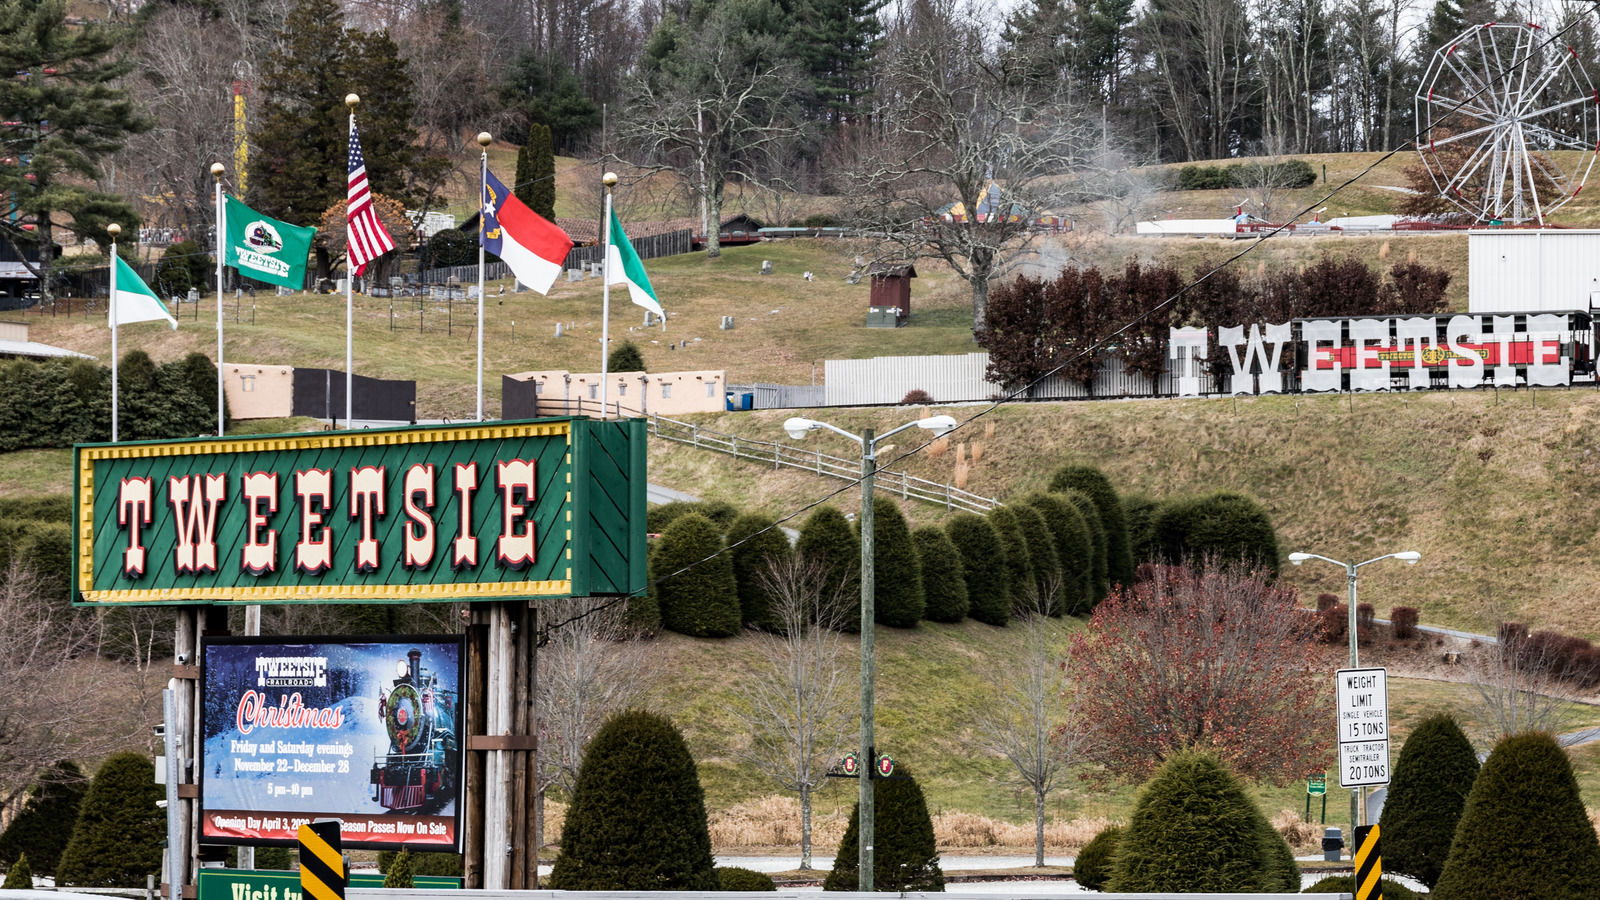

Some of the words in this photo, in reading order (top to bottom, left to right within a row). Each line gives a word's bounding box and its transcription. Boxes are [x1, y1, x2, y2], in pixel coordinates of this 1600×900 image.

[1170, 315, 1569, 396] TWEETSIE
[117, 458, 537, 580] TWEETSIE
[256, 657, 328, 687] TWEETSIE
[1347, 675, 1377, 689] WEIGHT
[1351, 694, 1372, 707] LIMIT
[237, 690, 345, 734] Christmas
[1343, 711, 1360, 719] SINGLE
[1363, 709, 1383, 718] VEHICLE
[1348, 722, 1360, 737] 15
[1362, 722, 1384, 736] TONS
[231, 740, 258, 757] Friday
[259, 741, 275, 754] and
[277, 741, 315, 758] Saturday
[316, 741, 354, 758] evenings
[1343, 745, 1360, 753] TRUCK
[1363, 743, 1385, 752] TRACTOR
[234, 758, 275, 772] November
[337, 760, 350, 773] 28
[847, 758, 853, 769] E
[882, 760, 889, 770] F
[1349, 754, 1380, 763] SEMITRAILER
[1349, 766, 1361, 780] 20
[1363, 765, 1386, 778] TONS
[267, 783, 274, 795] 5
[301, 786, 314, 798] pm
[214, 815, 247, 831] Opening
[247, 816, 262, 831] Day
[262, 817, 281, 832] April
[282, 817, 290, 832] 3,
[340, 819, 366, 833] Season
[368, 820, 395, 834] Passes
[397, 821, 415, 834] Now
[416, 822, 428, 834] On
[429, 822, 447, 835] Sale
[231, 883, 278, 900] Visit
